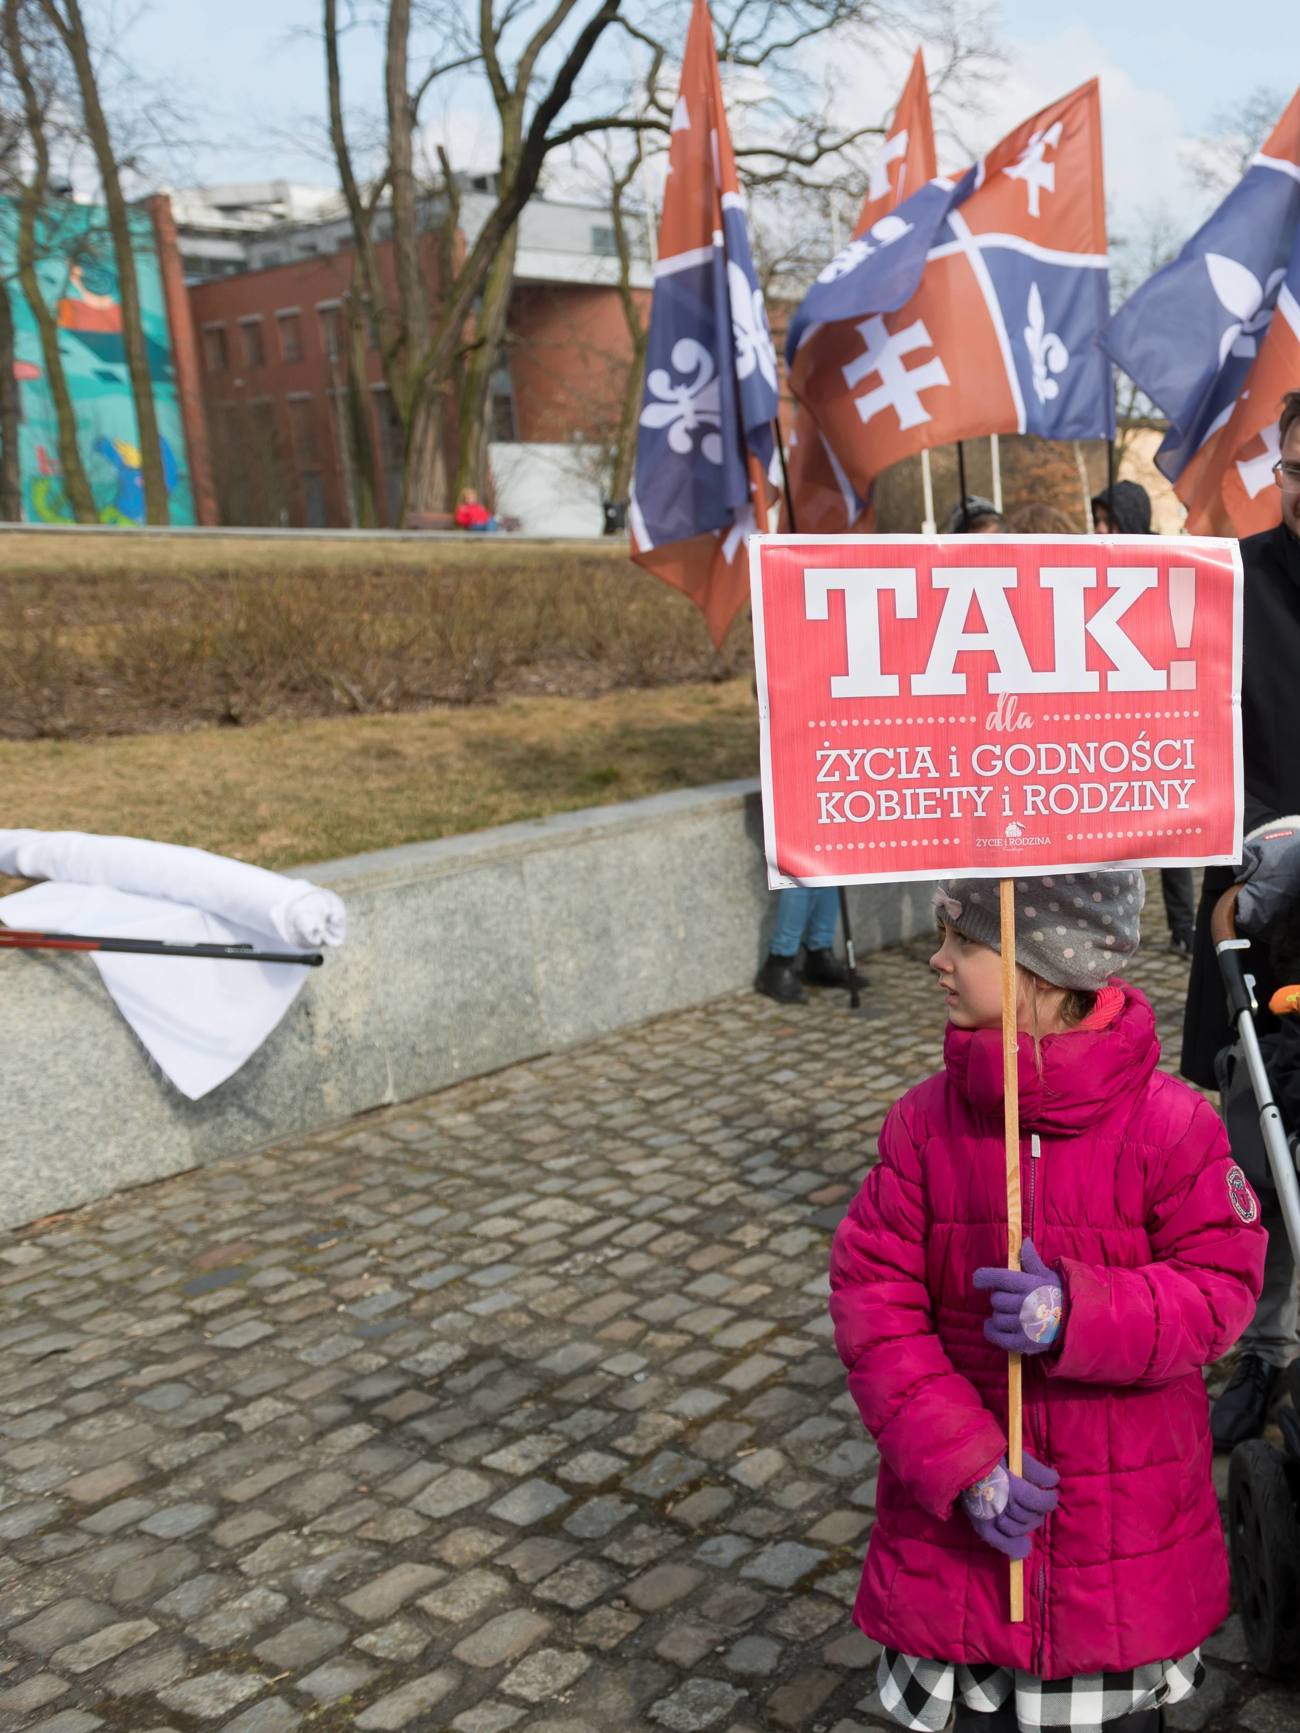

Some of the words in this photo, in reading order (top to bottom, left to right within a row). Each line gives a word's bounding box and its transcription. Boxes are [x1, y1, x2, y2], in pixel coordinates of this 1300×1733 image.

[804, 567, 1197, 698] TAK!
[985, 690, 1035, 732] dla
[816, 740, 940, 782] ŻYCIA
[949, 745, 960, 777] i
[971, 731, 1195, 776] GODNOŚCI
[817, 786, 993, 824] KOBIETY
[1002, 786, 1013, 817] i
[1023, 779, 1195, 816] RODZINY
[1009, 836, 1051, 847] RODZINA
